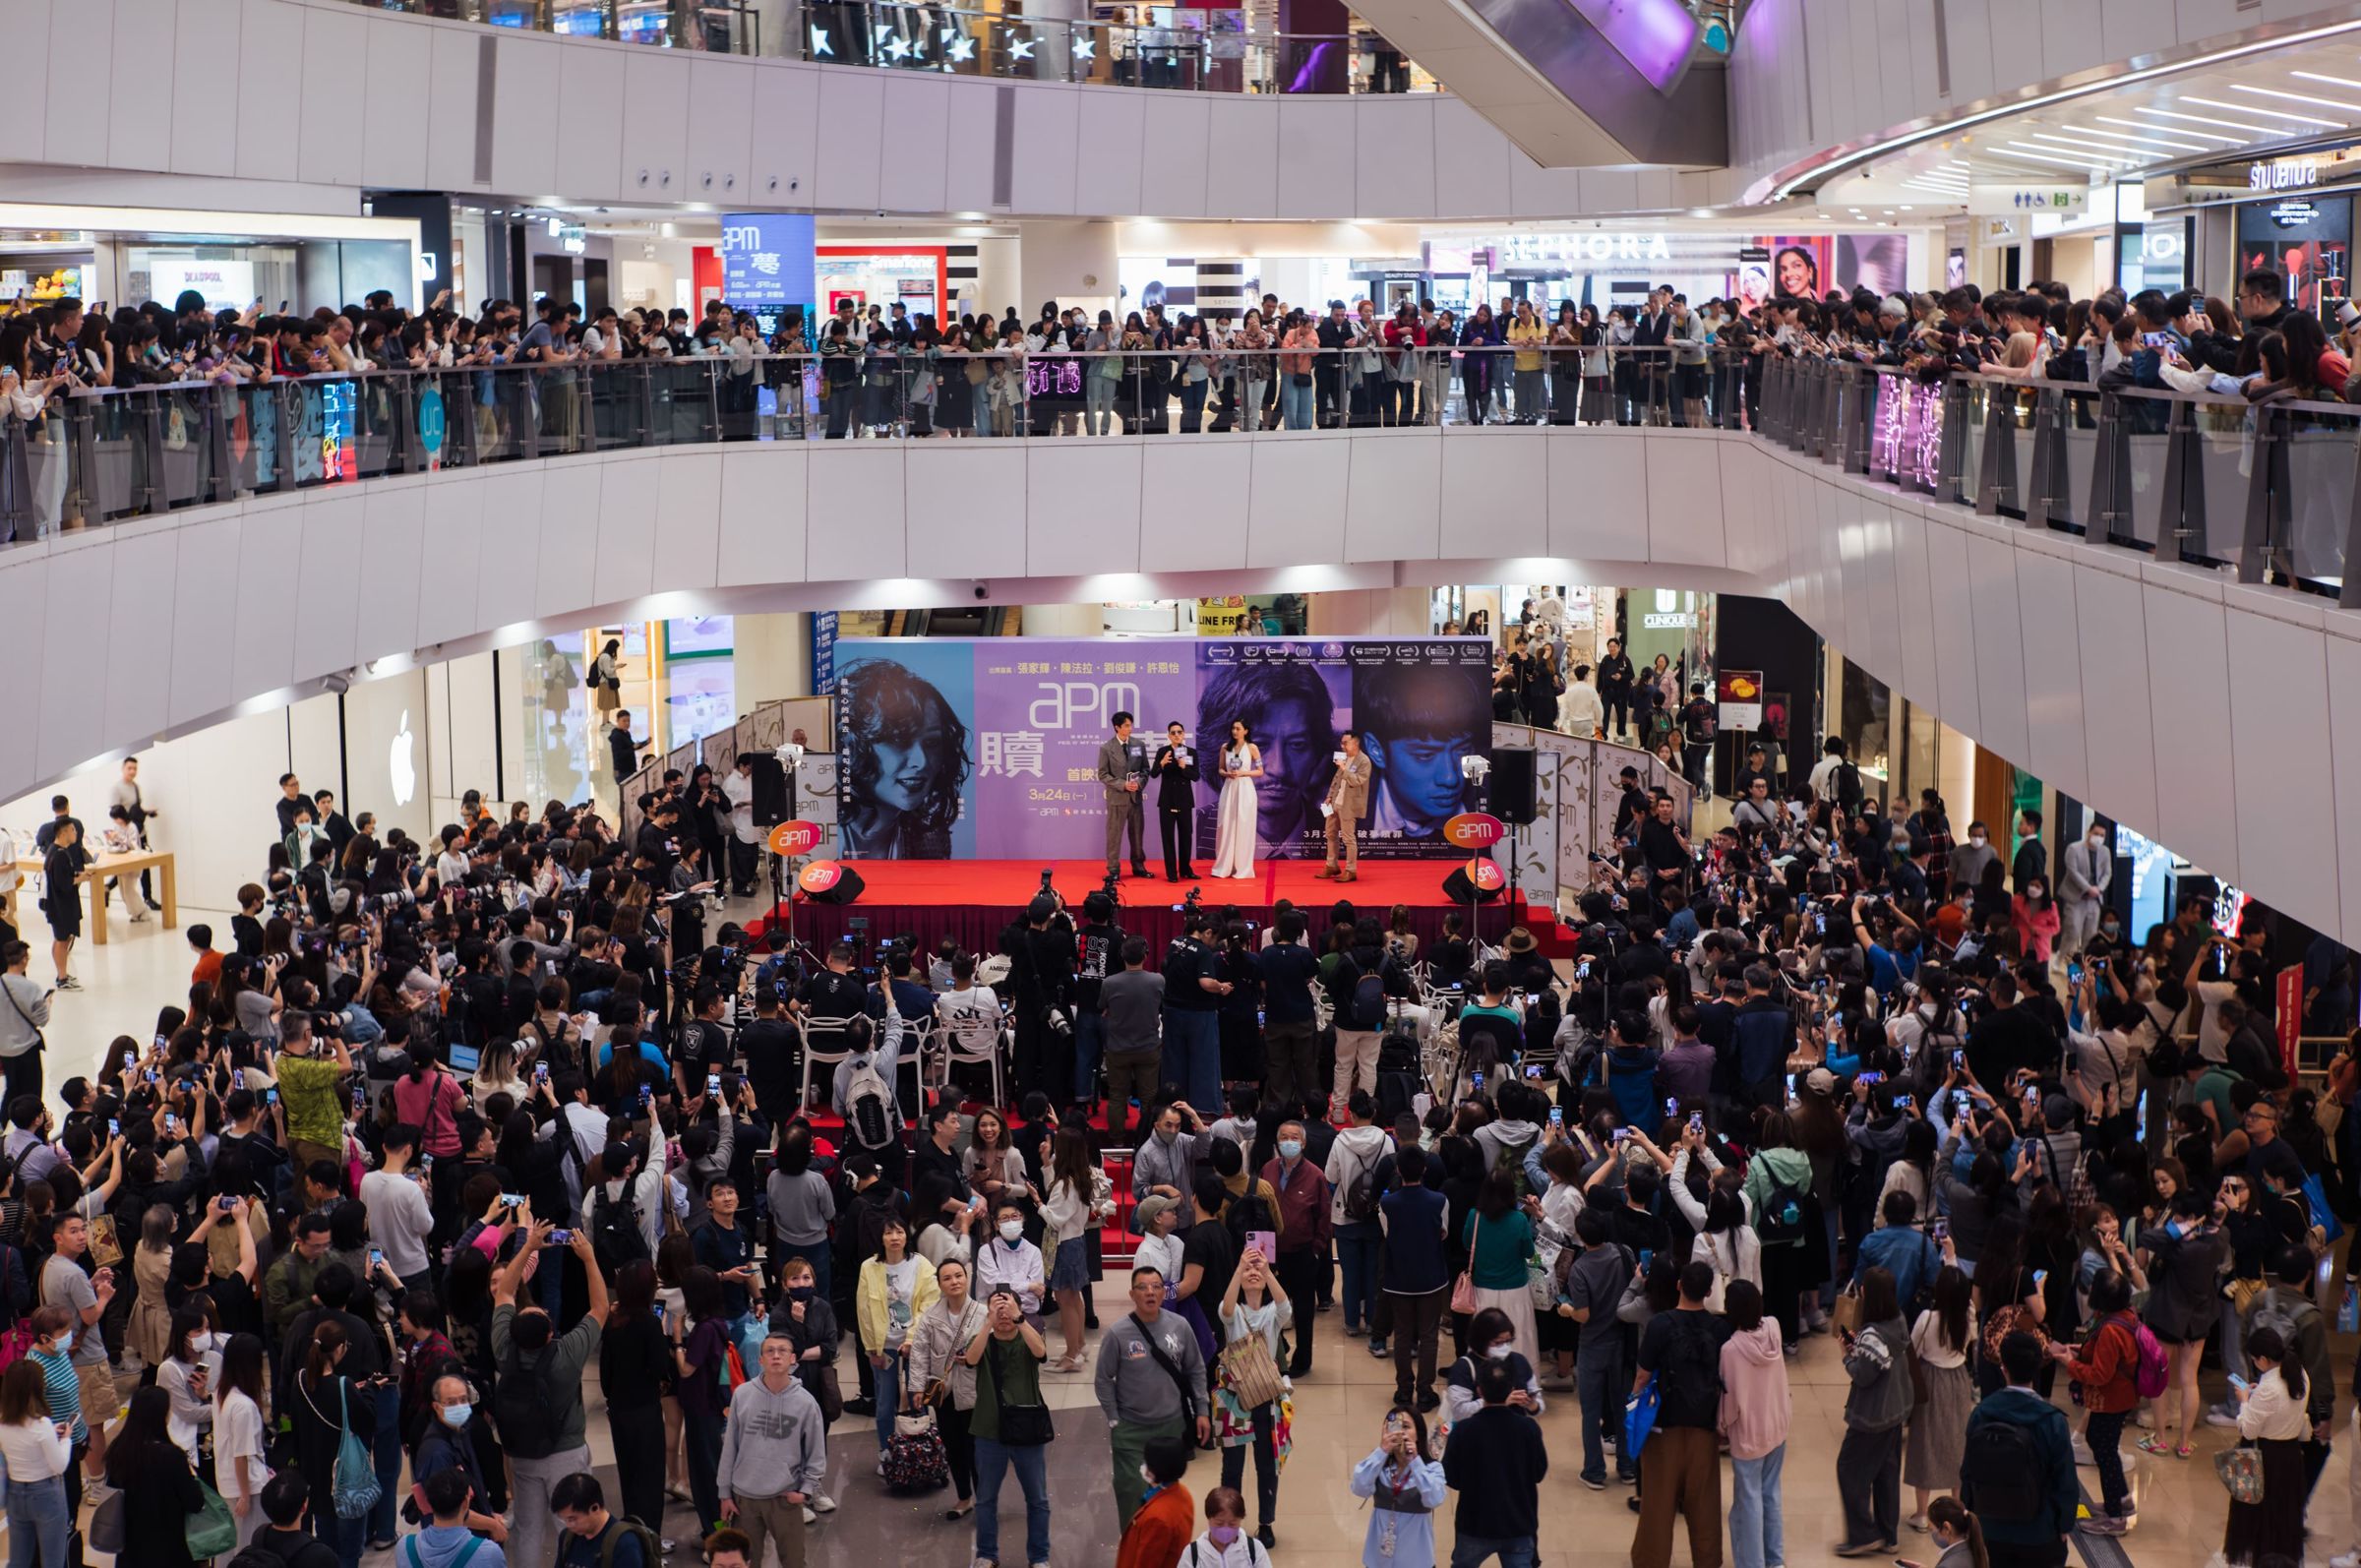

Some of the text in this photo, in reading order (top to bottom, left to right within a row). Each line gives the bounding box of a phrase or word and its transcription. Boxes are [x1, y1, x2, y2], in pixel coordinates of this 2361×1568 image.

[2251, 162, 2270, 191] shu
[1198, 615, 1218, 626] LINE
[1029, 682, 1140, 729] apm
[1066, 768, 1100, 782] 首映
[1559, 802, 1577, 827] pm
[778, 829, 811, 847] apm
[1456, 822, 1492, 838] apm
[806, 868, 833, 884] apm
[1529, 888, 1553, 902] apm
